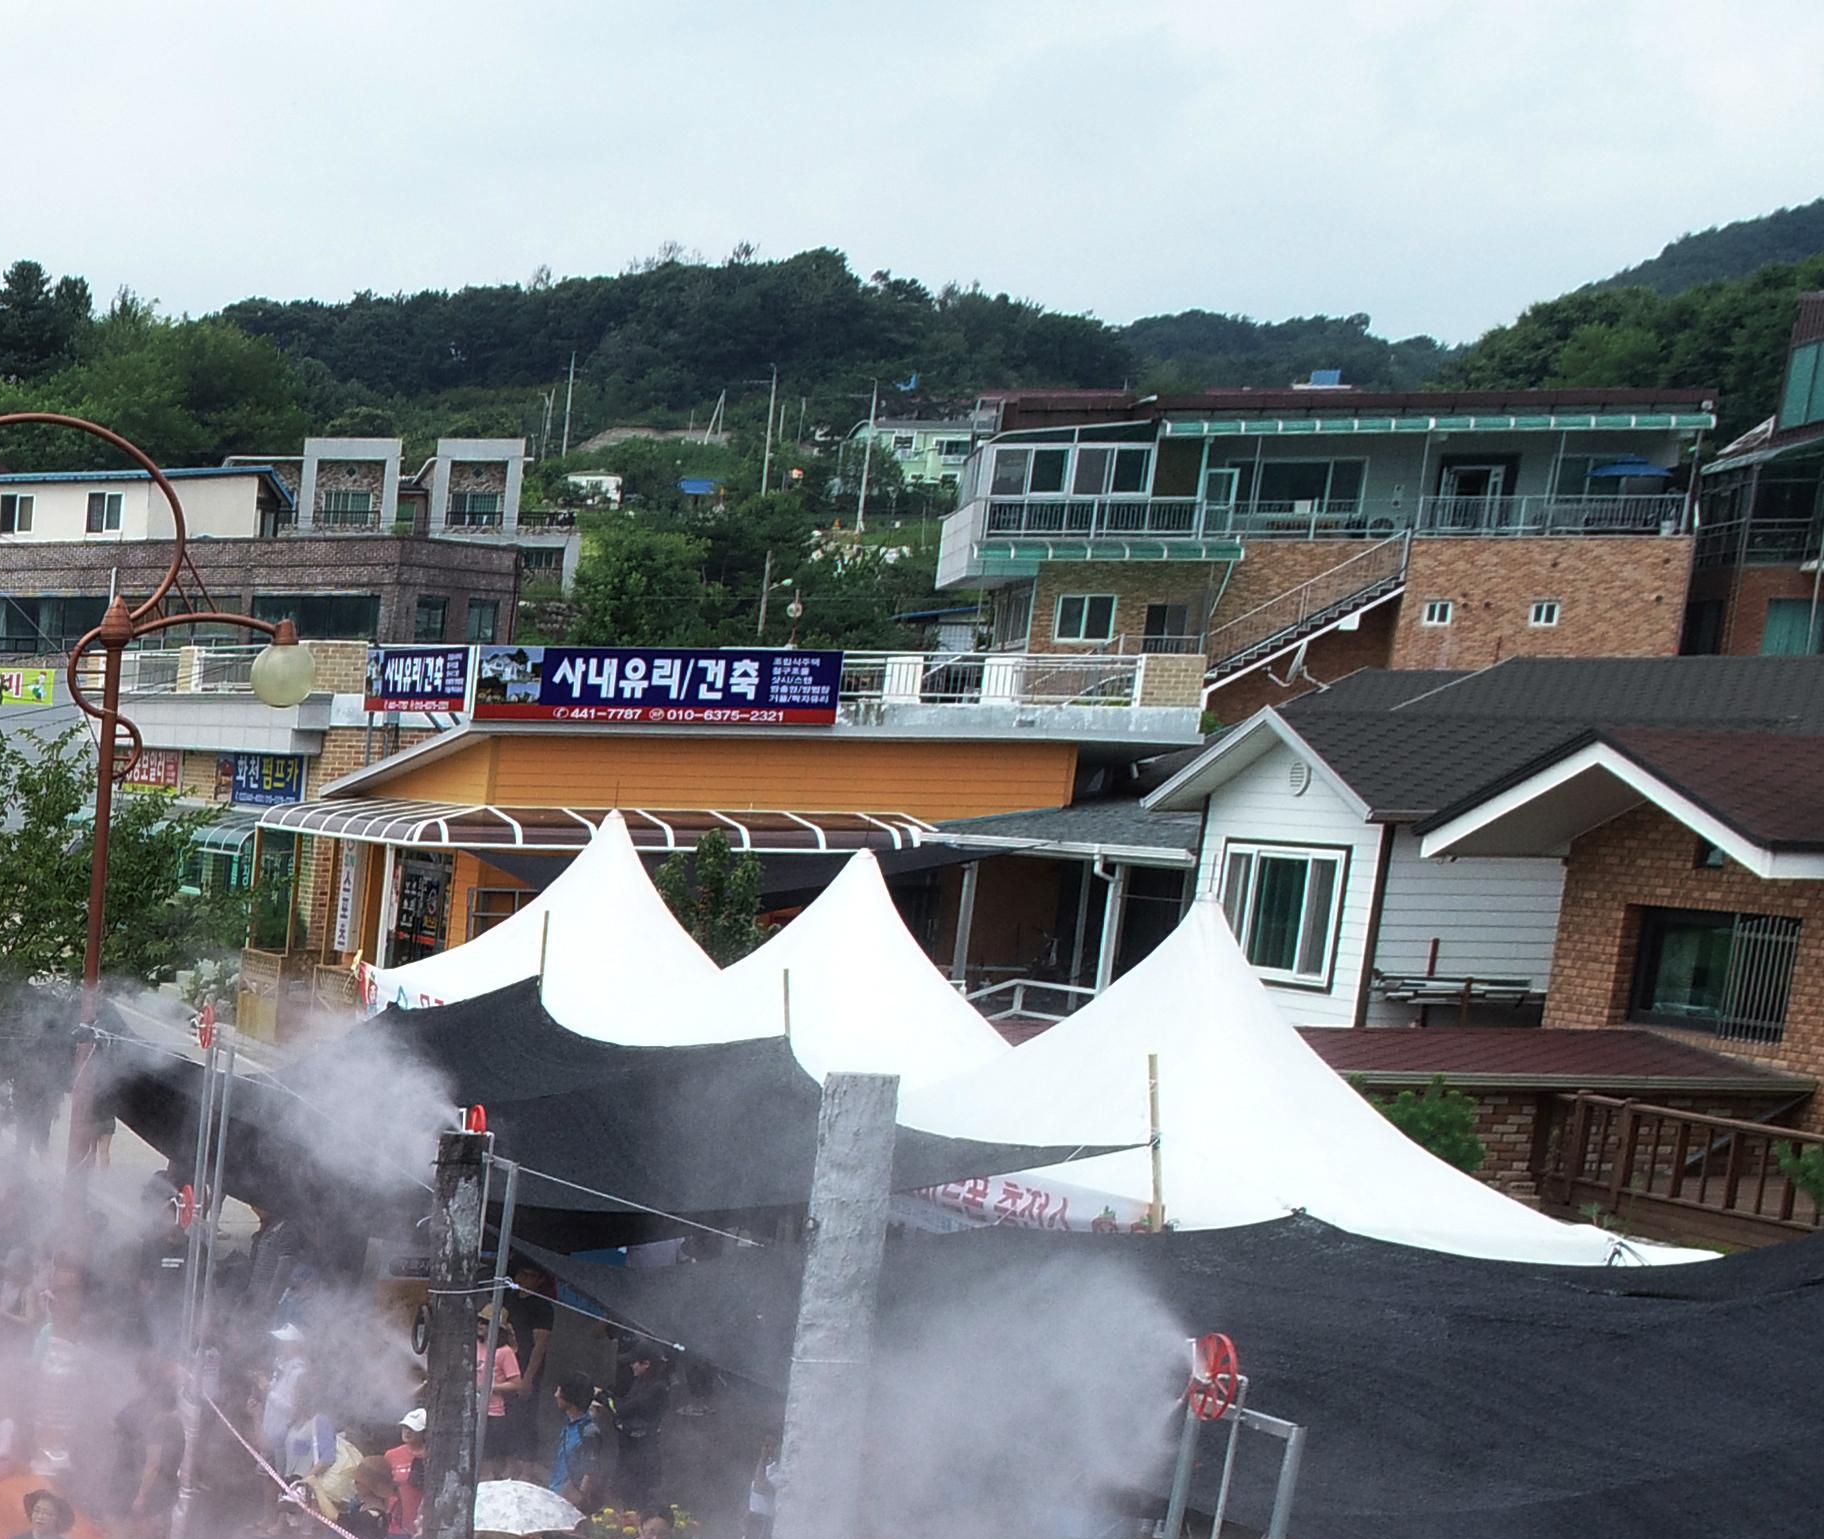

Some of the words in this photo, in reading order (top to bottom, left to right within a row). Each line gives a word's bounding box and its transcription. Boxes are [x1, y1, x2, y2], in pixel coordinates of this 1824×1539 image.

[552, 657, 760, 700] 사내유리/건축
[570, 708, 642, 719] 441-7787
[666, 709, 784, 722] 010-6375-2321
[236, 756, 259, 789] 화천
[261, 757, 299, 793] 펌프카
